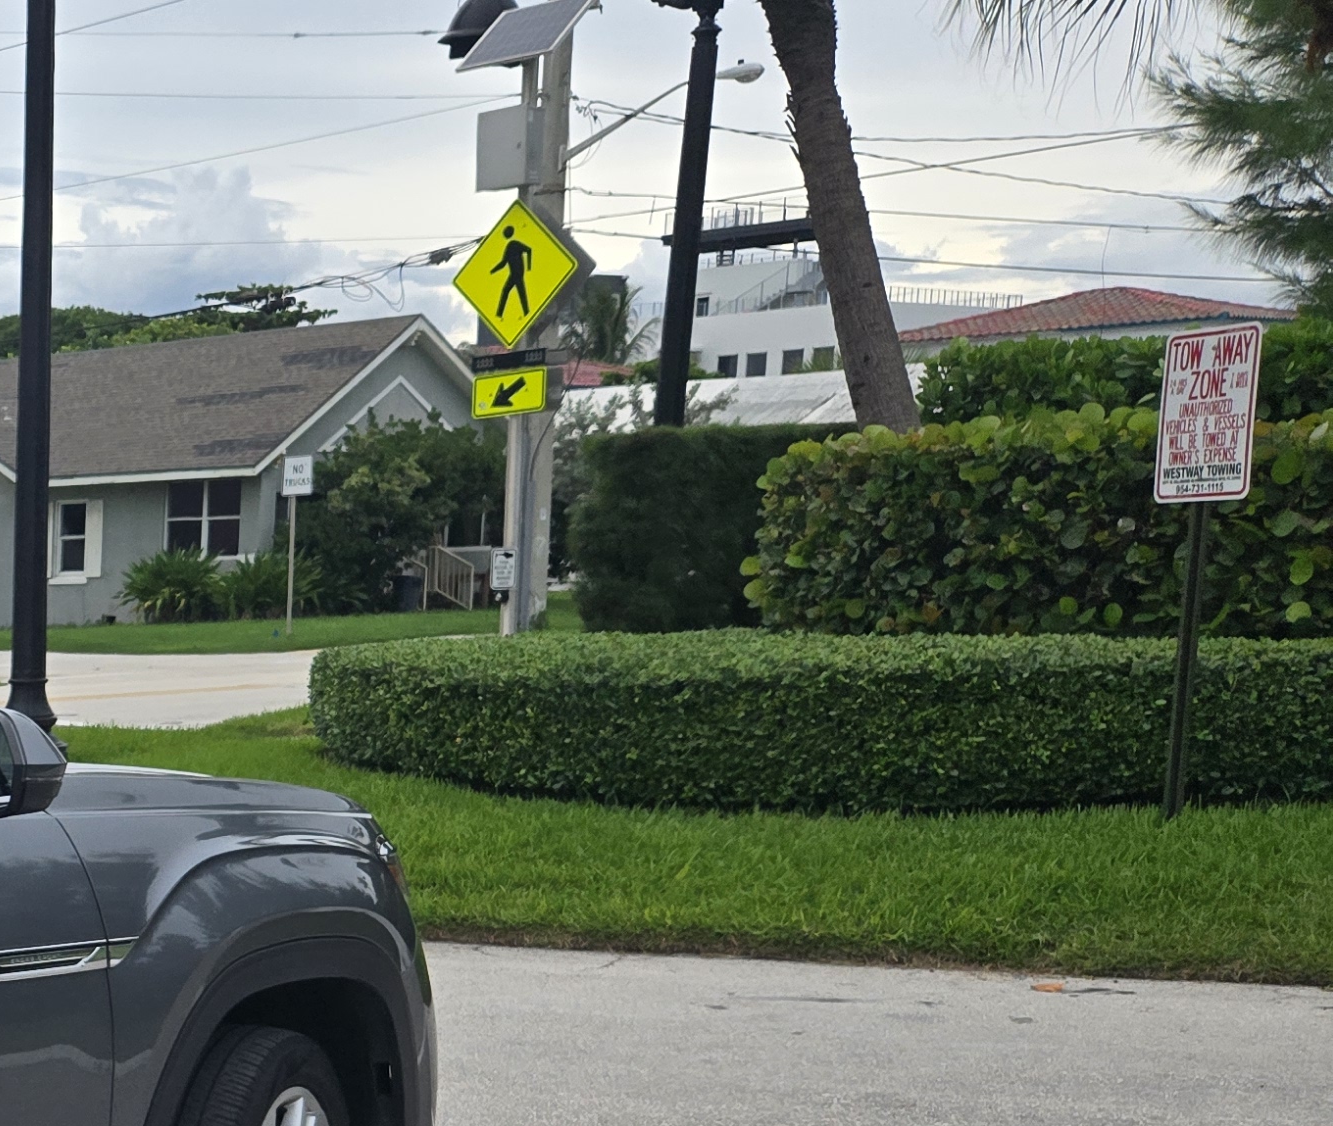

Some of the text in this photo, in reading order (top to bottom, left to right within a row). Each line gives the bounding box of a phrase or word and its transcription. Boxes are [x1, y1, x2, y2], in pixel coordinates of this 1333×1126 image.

[1173, 332, 1254, 372] TOW AWAY
[1188, 368, 1229, 401] ZONE
[1179, 398, 1233, 418] UNAUTHORIZED
[1166, 413, 1246, 435] VEHICLES & VESSELS
[1169, 430, 1239, 450] WILL BE TOWED AT
[1169, 446, 1237, 466] OWNER'S EXPENSE
[292, 464, 304, 474] NO
[1163, 463, 1242, 480] WESTWAY TOWING
